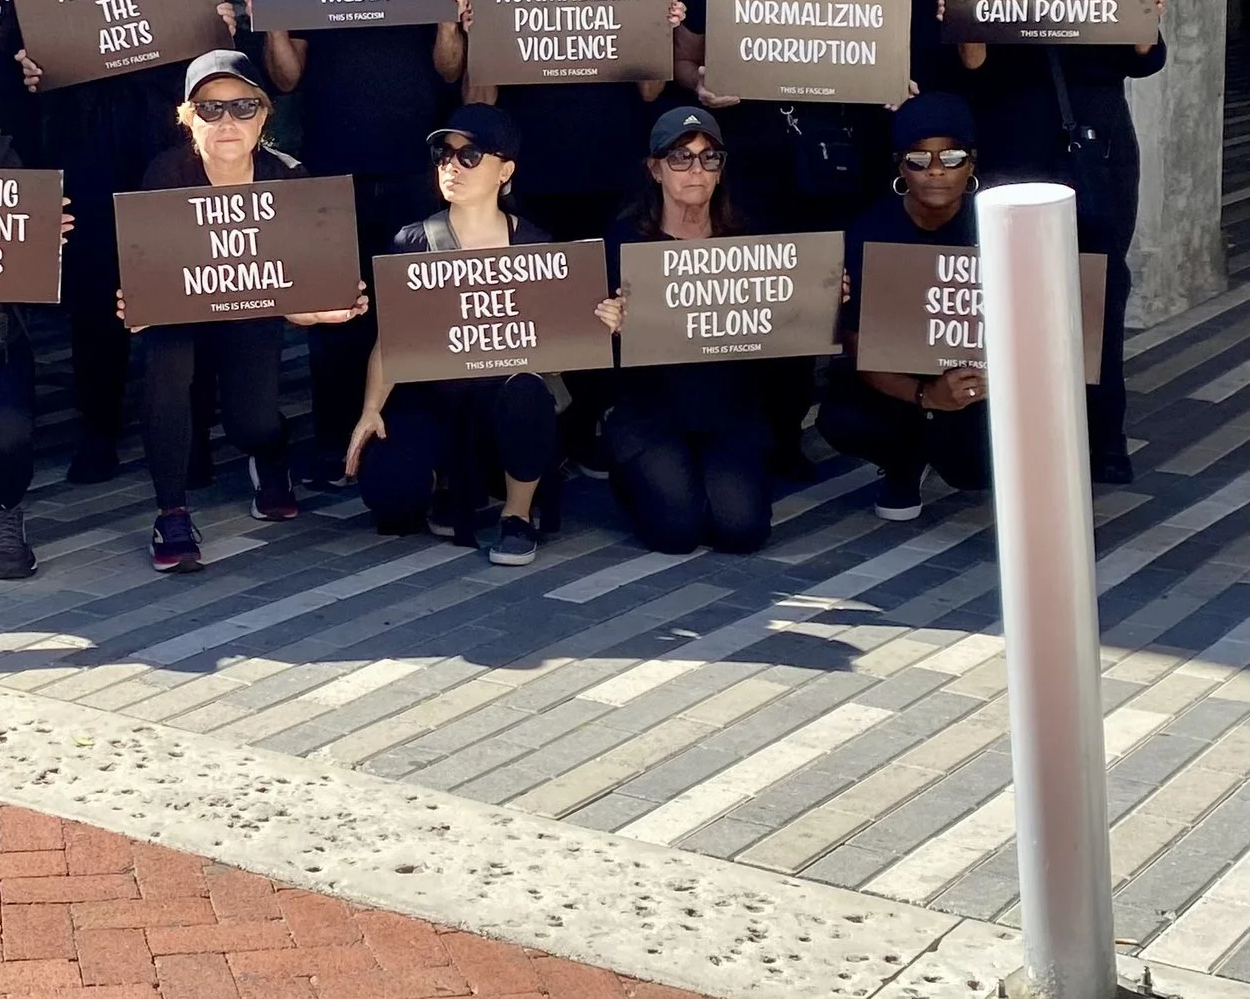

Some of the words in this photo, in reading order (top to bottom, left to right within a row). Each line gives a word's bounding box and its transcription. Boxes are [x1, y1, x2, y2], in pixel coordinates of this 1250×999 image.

[328, 13, 345, 21] THIS
[354, 11, 385, 21] FASCISM
[515, 5, 621, 32] POLITICAL
[735, 0, 883, 28] NORMALIZING
[1035, 0, 1119, 23] POWER
[99, 20, 153, 54] ARTS
[517, 35, 618, 61] VIOLENCE
[740, 37, 876, 65] CORRUPTION
[105, 59, 123, 69] THIS
[130, 51, 160, 64] FASCISM
[542, 68, 559, 77] THIS
[568, 68, 598, 76] FASCISM
[780, 86, 797, 94] THIS
[805, 87, 835, 95] FASCISM
[188, 194, 245, 226] THIS
[252, 192, 275, 221] IS
[210, 228, 259, 259] NOT
[407, 252, 568, 290] SUPPRESSING
[664, 243, 797, 277] PARDONING
[938, 254, 982, 284] USI
[183, 260, 293, 295] NORMAL
[665, 275, 793, 308] CONVICTED
[211, 303, 229, 312] THIS
[240, 299, 275, 309] FASCISM
[459, 289, 519, 319] FREE
[925, 286, 985, 316] SECR
[448, 321, 537, 353] SPEECH
[686, 308, 772, 338] FELONS
[929, 319, 984, 349] POLI
[702, 346, 720, 354] THIS
[729, 343, 761, 352] FASCISM
[938, 358, 958, 367] THIS
[465, 361, 484, 370] THIS
[494, 358, 528, 367] FASCISM
